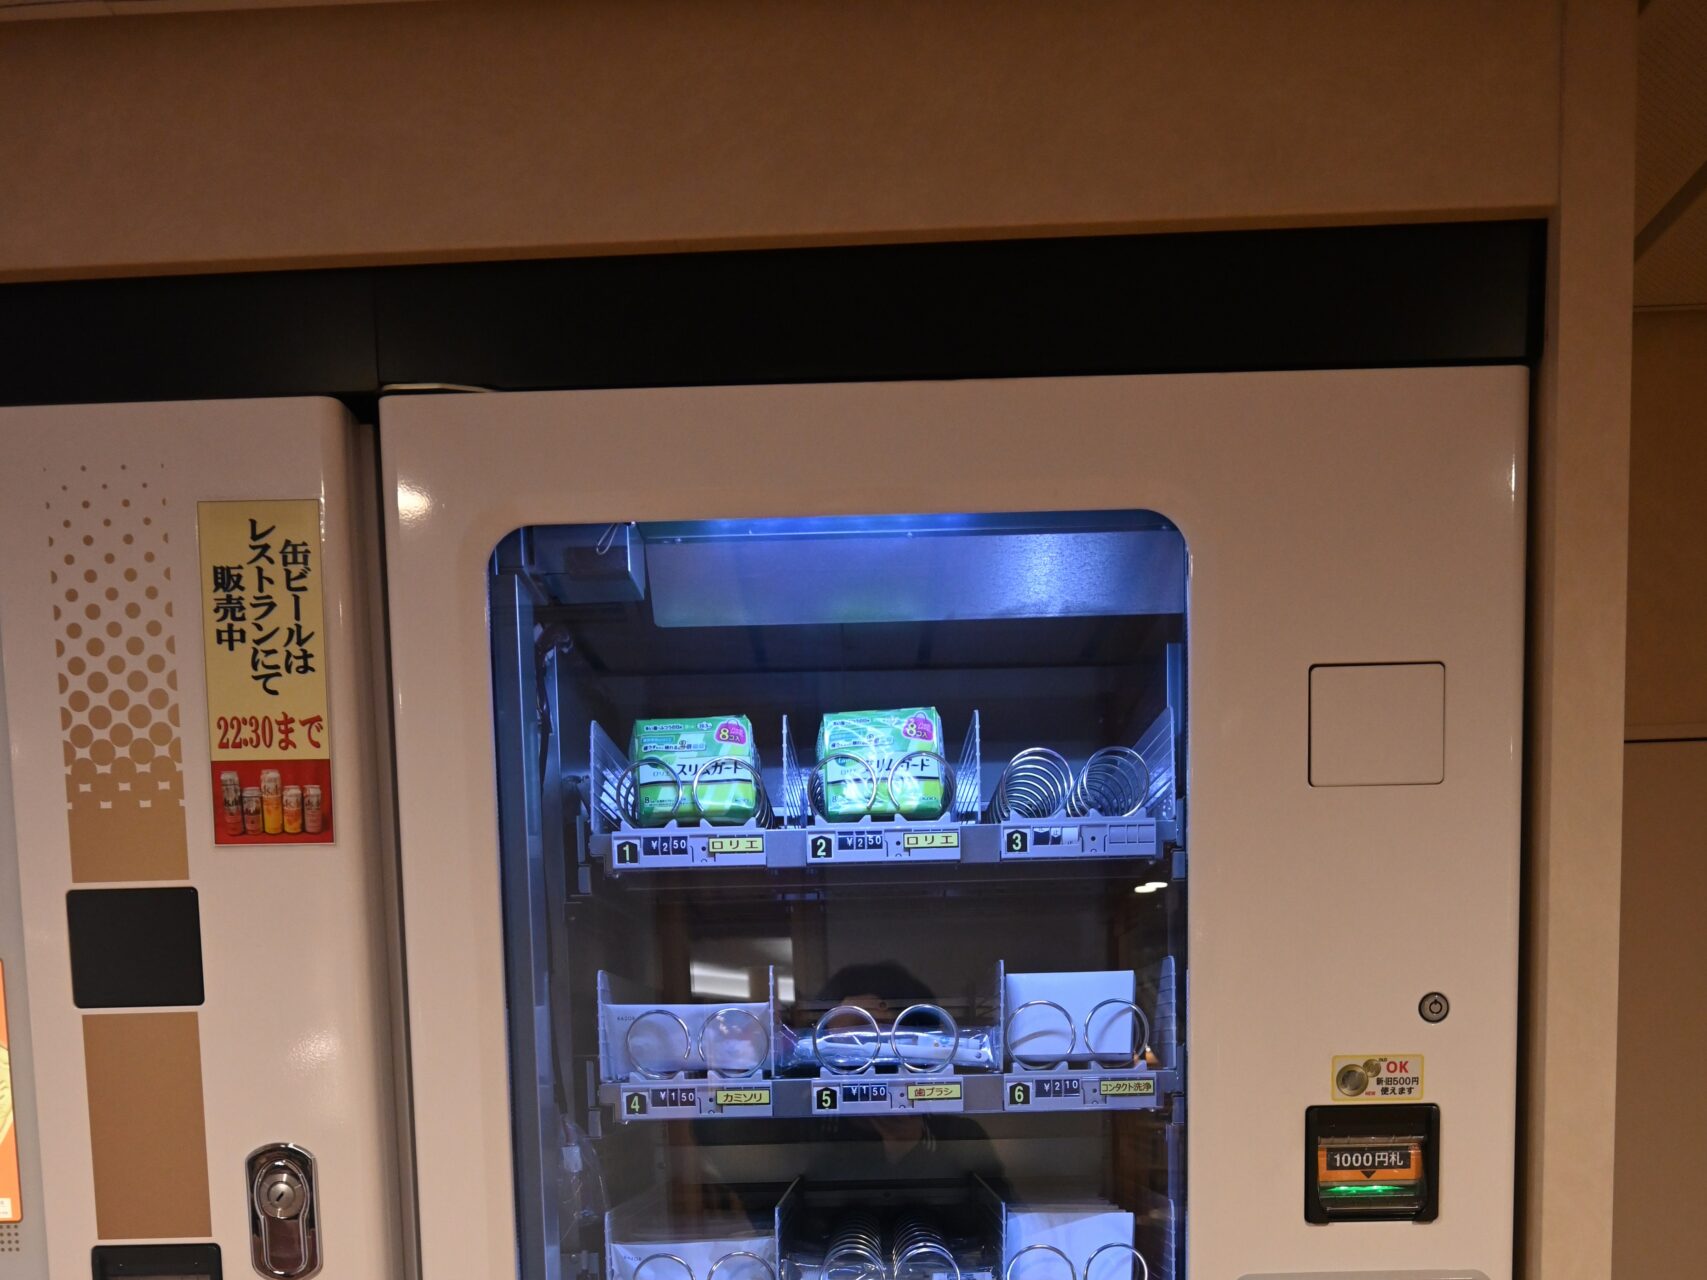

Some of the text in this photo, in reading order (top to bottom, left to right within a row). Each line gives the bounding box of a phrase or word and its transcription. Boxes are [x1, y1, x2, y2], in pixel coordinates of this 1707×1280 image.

[213, 565, 246, 651] 販売中
[247, 518, 283, 695] レストランにて
[280, 539, 316, 674] 缶ビールは
[217, 712, 323, 751] 22:30まで
[711, 839, 759, 850] ロリエ
[816, 839, 826, 856] 2
[907, 835, 954, 845] ロリエ
[1012, 833, 1022, 850] 3
[622, 844, 630, 860] 1
[1386, 1061, 1409, 1073] OK
[914, 1087, 953, 1098] 歯ブラシ
[1014, 1085, 1024, 1102] 6
[1101, 1082, 1152, 1092] コンタクト洗浄
[1380, 1087, 1415, 1096] 使えます
[630, 1095, 640, 1111] 4
[723, 1092, 762, 1102] カミソリ
[821, 1090, 831, 1107] 5
[1334, 1151, 1404, 1167] 1000円札
